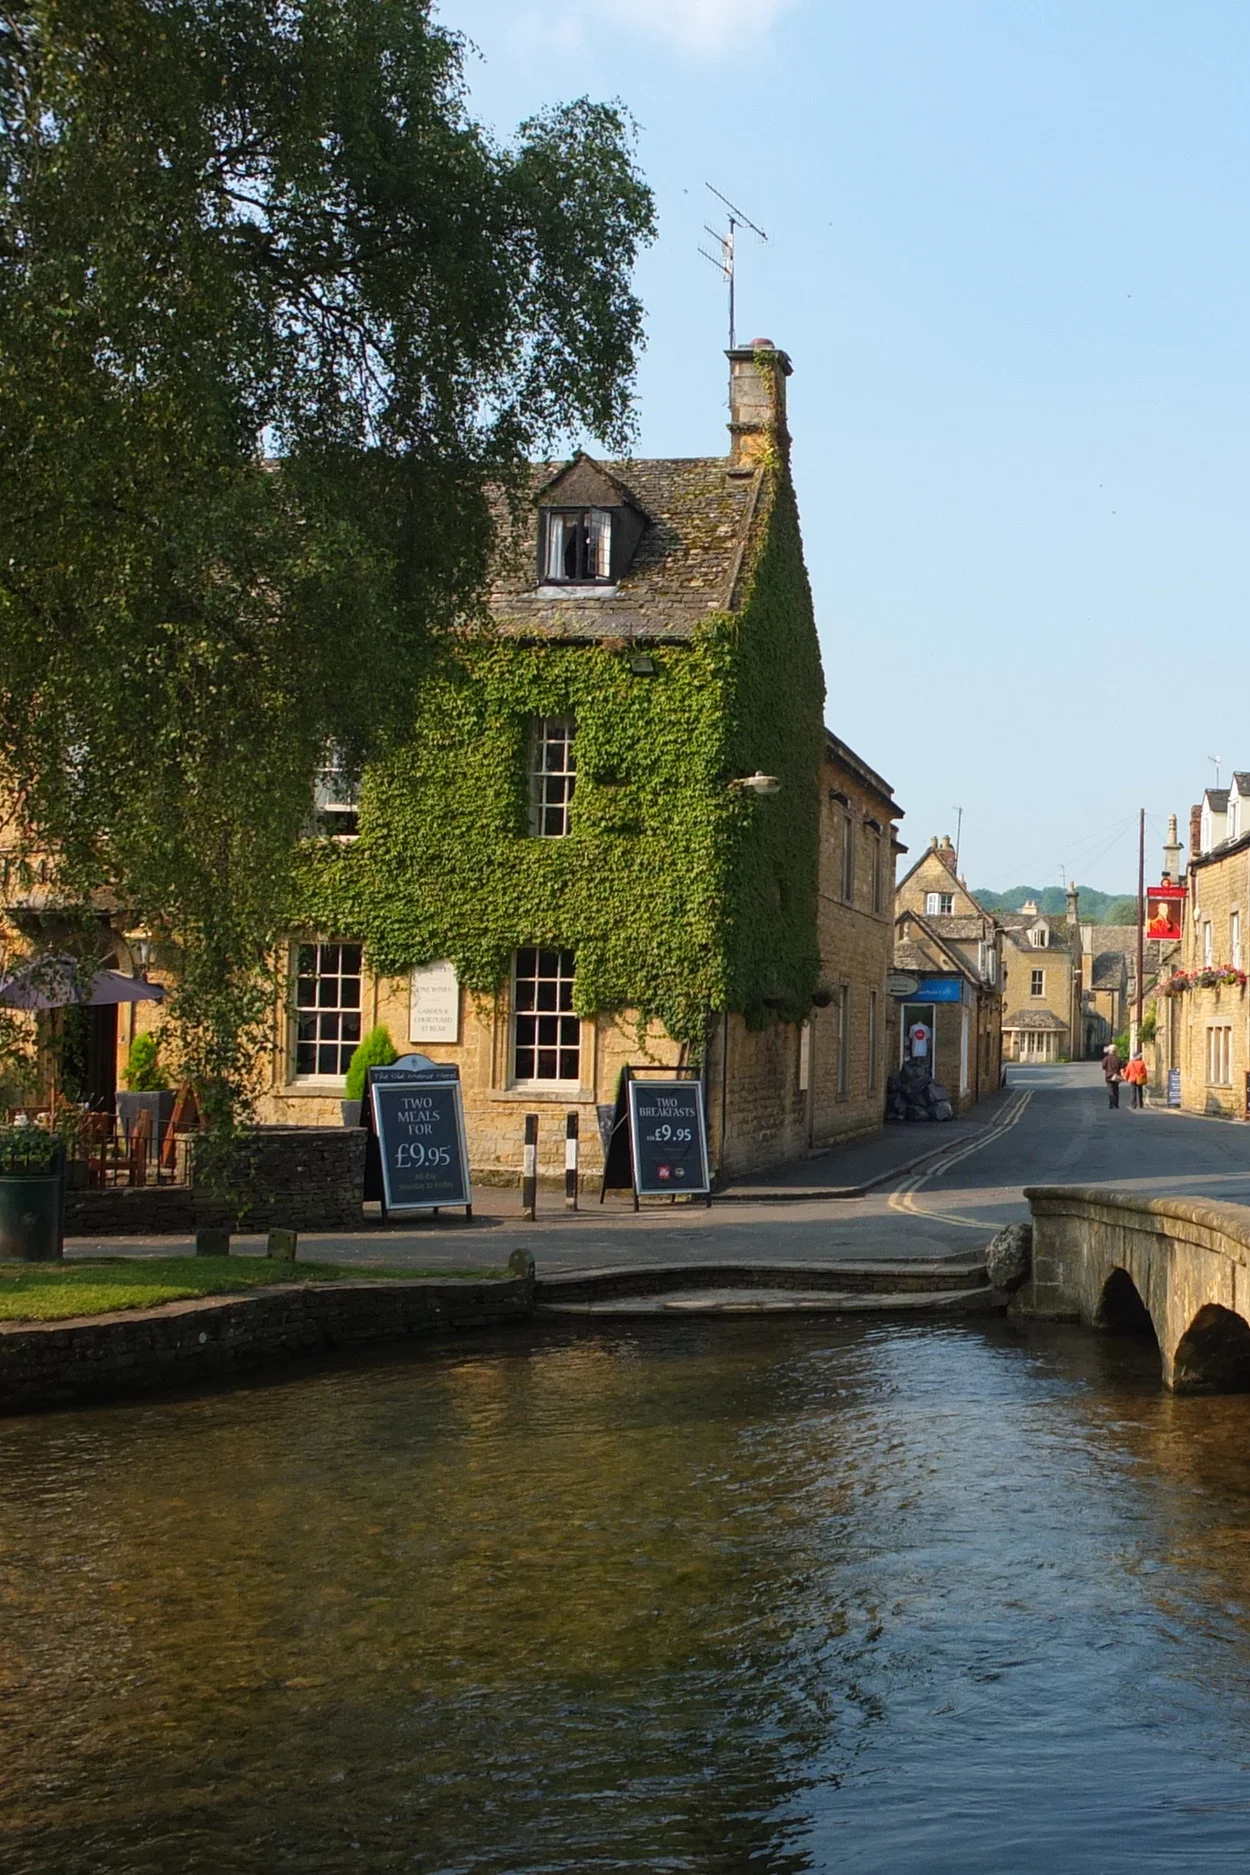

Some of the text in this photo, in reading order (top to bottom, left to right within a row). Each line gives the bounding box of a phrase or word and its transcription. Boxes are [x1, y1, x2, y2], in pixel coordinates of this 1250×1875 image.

[402, 1098, 432, 1109] TWO
[656, 1098, 677, 1107] TWO
[398, 1110, 440, 1122] MEALS
[640, 1107, 695, 1117] BREAKFASTS
[408, 1124, 432, 1135] FOR
[655, 1124, 691, 1141] £9.95
[395, 1142, 450, 1168] £9.95
